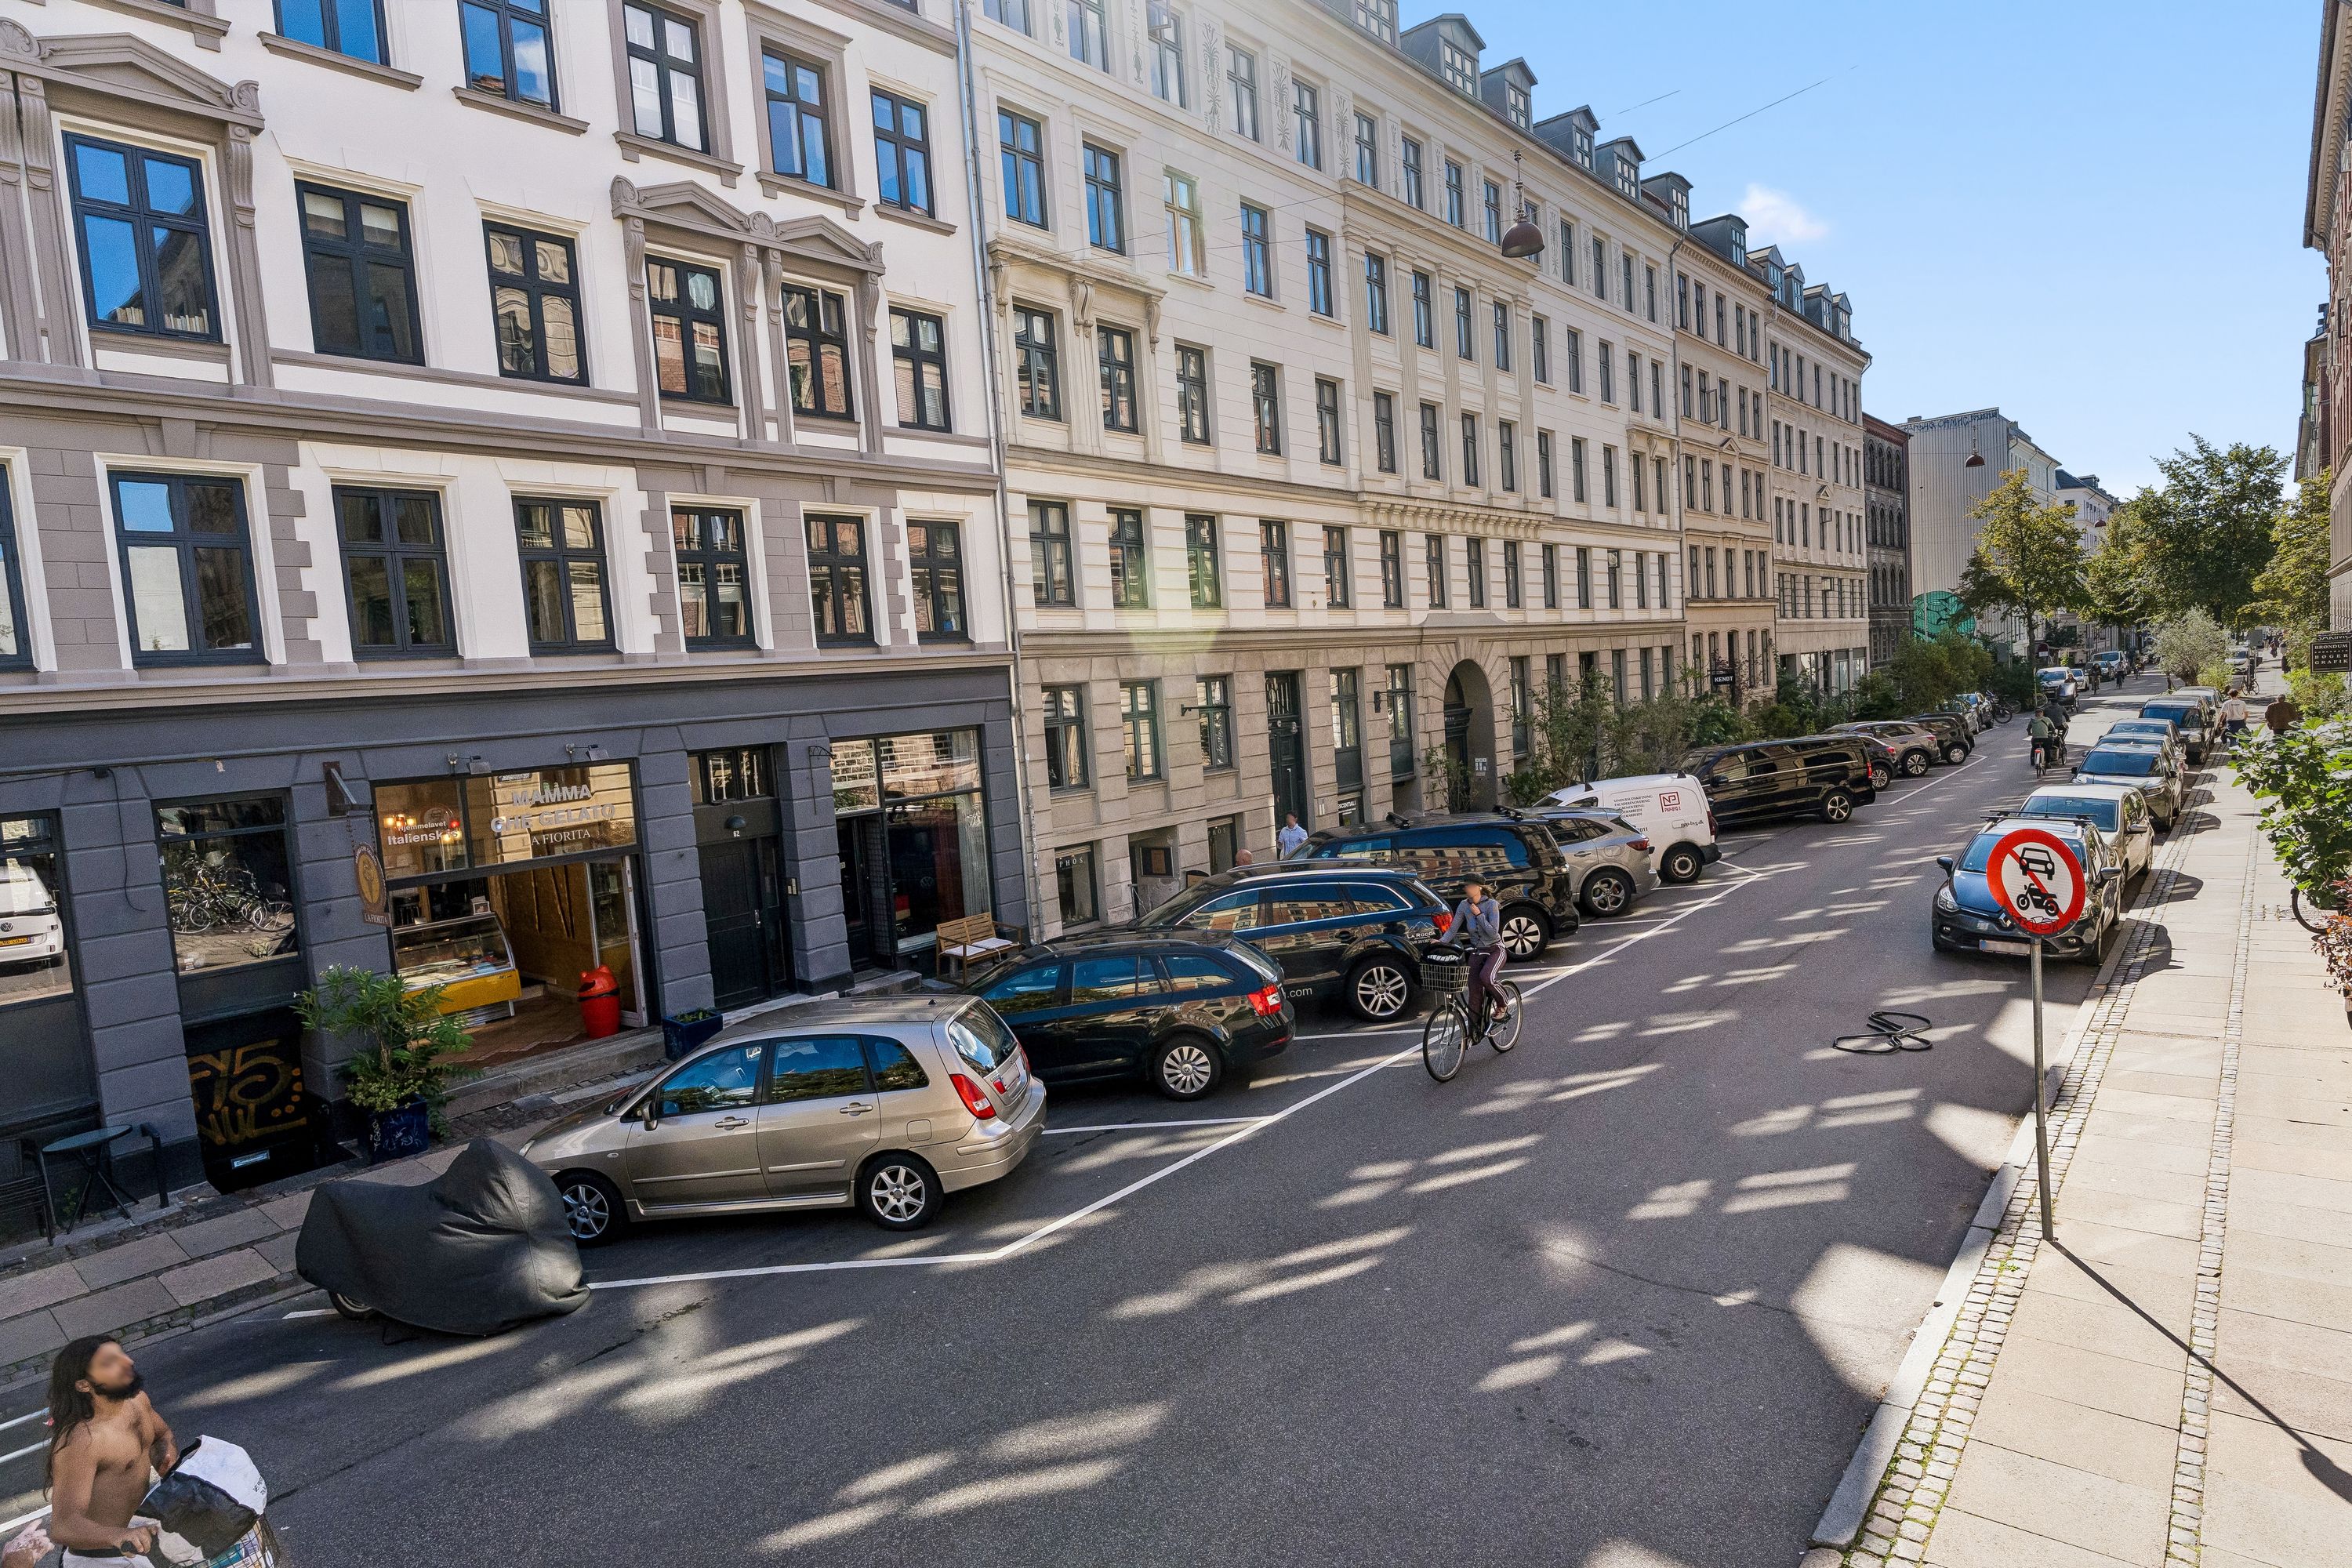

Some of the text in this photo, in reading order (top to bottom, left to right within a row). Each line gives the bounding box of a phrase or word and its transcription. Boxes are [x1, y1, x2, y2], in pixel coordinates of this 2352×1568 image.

[512, 785, 591, 807] MAMMA
[539, 803, 615, 827] GELATO
[397, 820, 446, 833] Hjemmelavet
[387, 830, 443, 846] Italiensk
[543, 829, 591, 844] FIORITA
[1059, 857, 1083, 868] PHOS
[1283, 987, 1312, 999] .com
